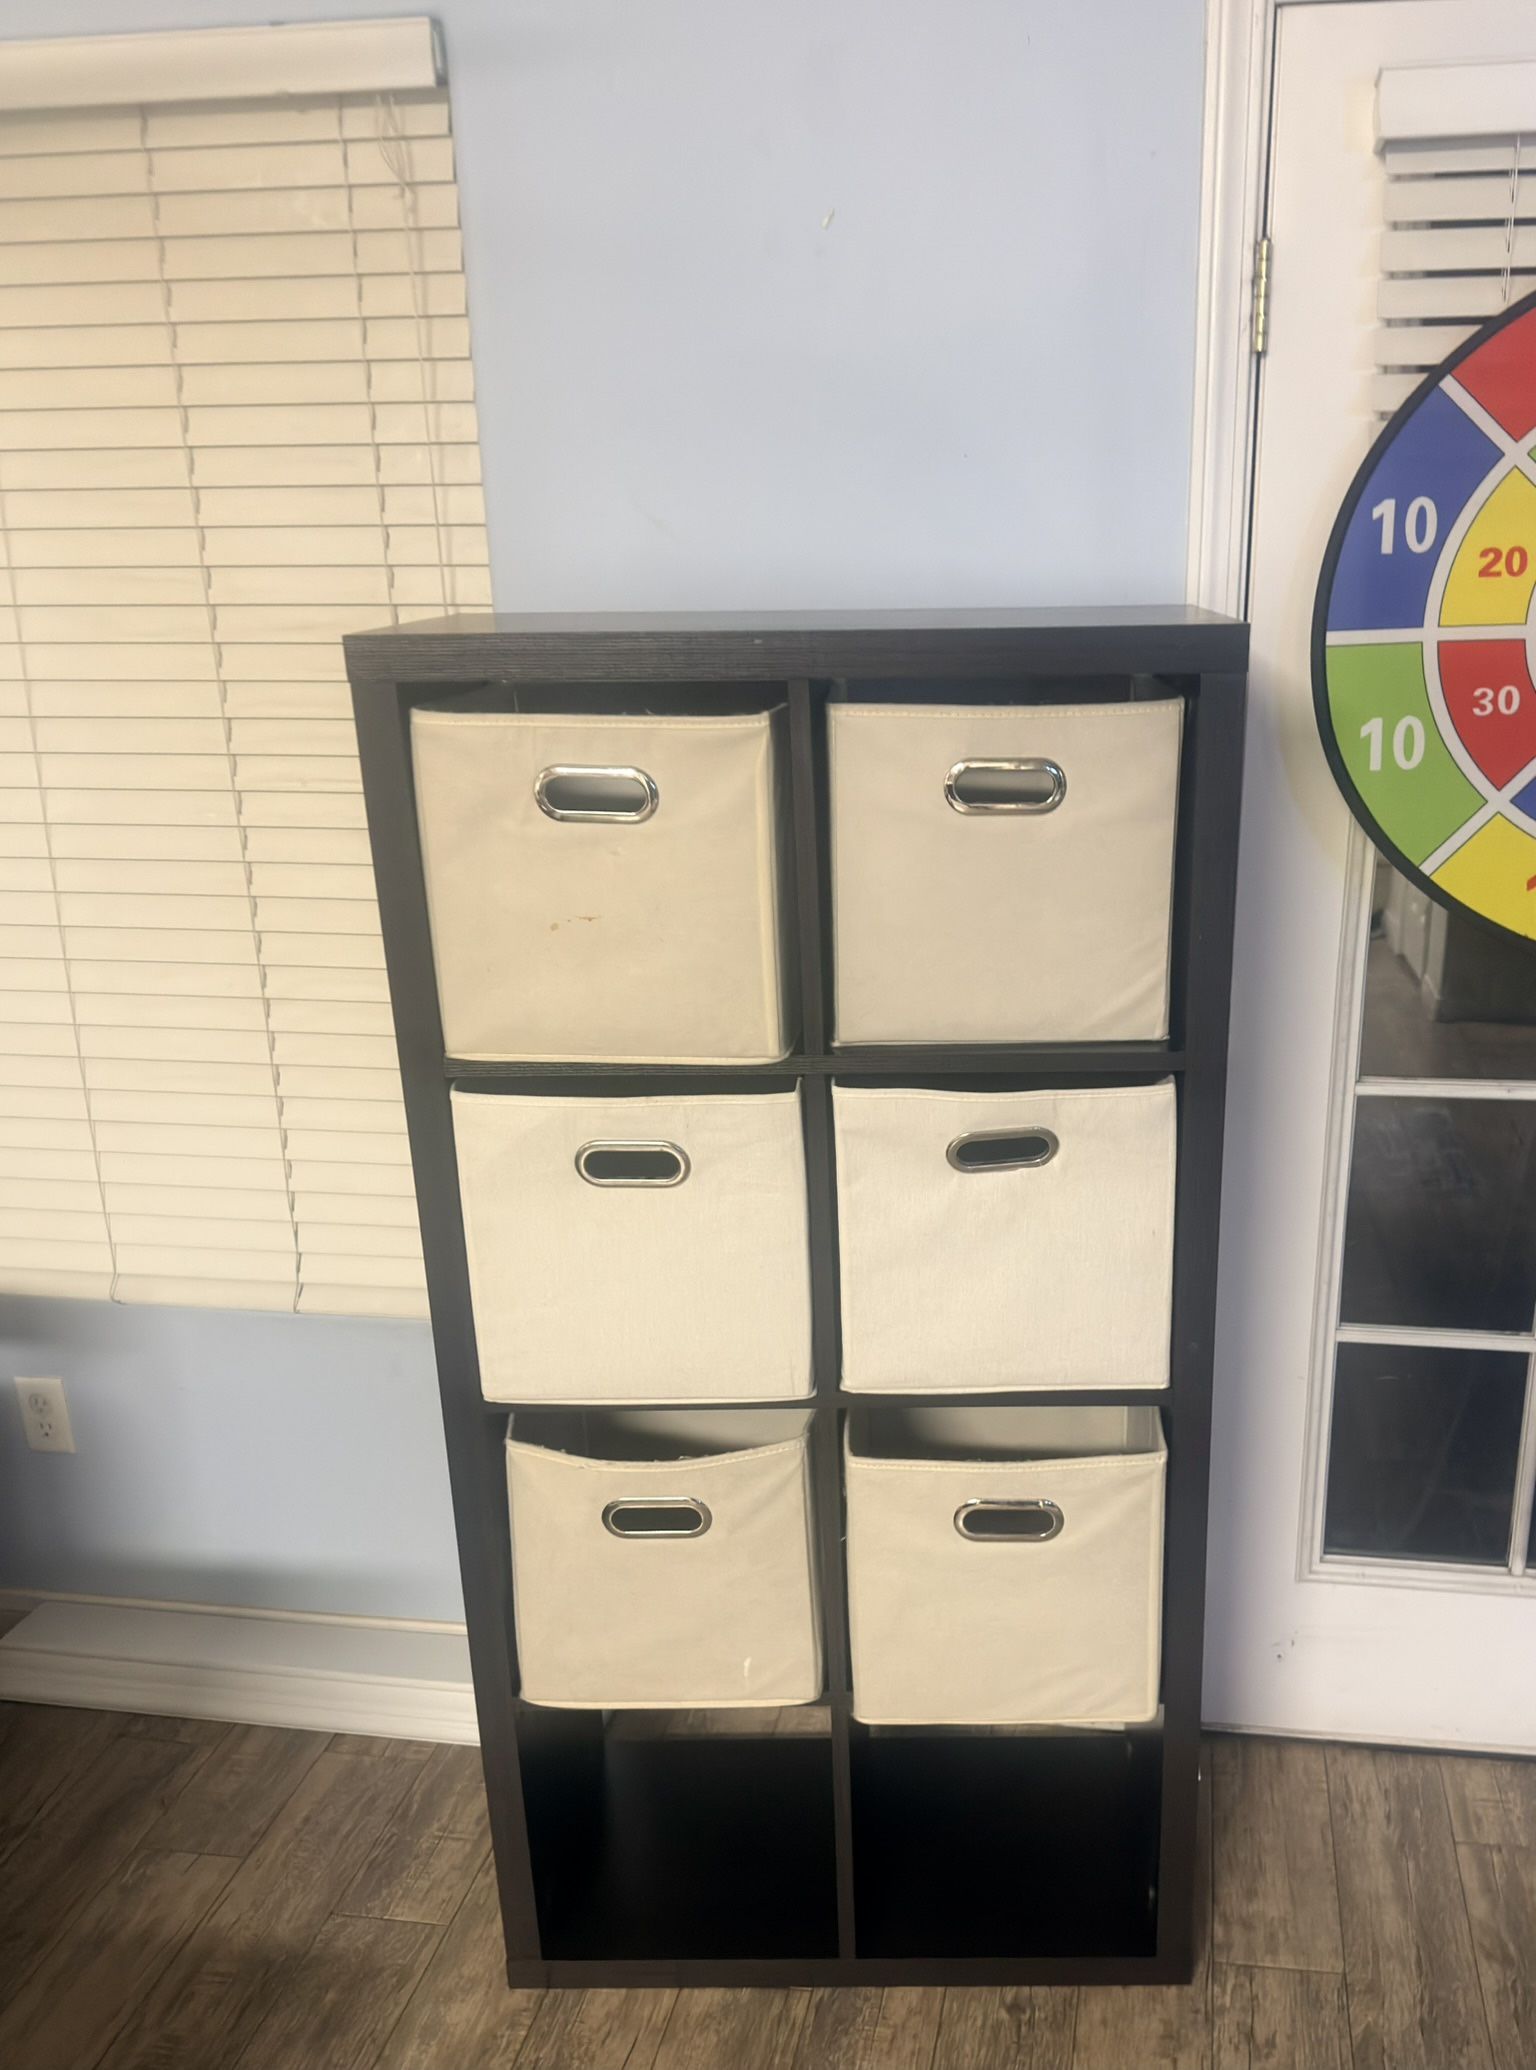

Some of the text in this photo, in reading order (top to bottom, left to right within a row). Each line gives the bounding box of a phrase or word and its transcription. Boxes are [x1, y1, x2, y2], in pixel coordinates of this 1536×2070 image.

[1372, 496, 1438, 555] 10
[1478, 546, 1528, 578] 20
[1472, 685, 1520, 716] 30
[1360, 715, 1425, 771] 10
